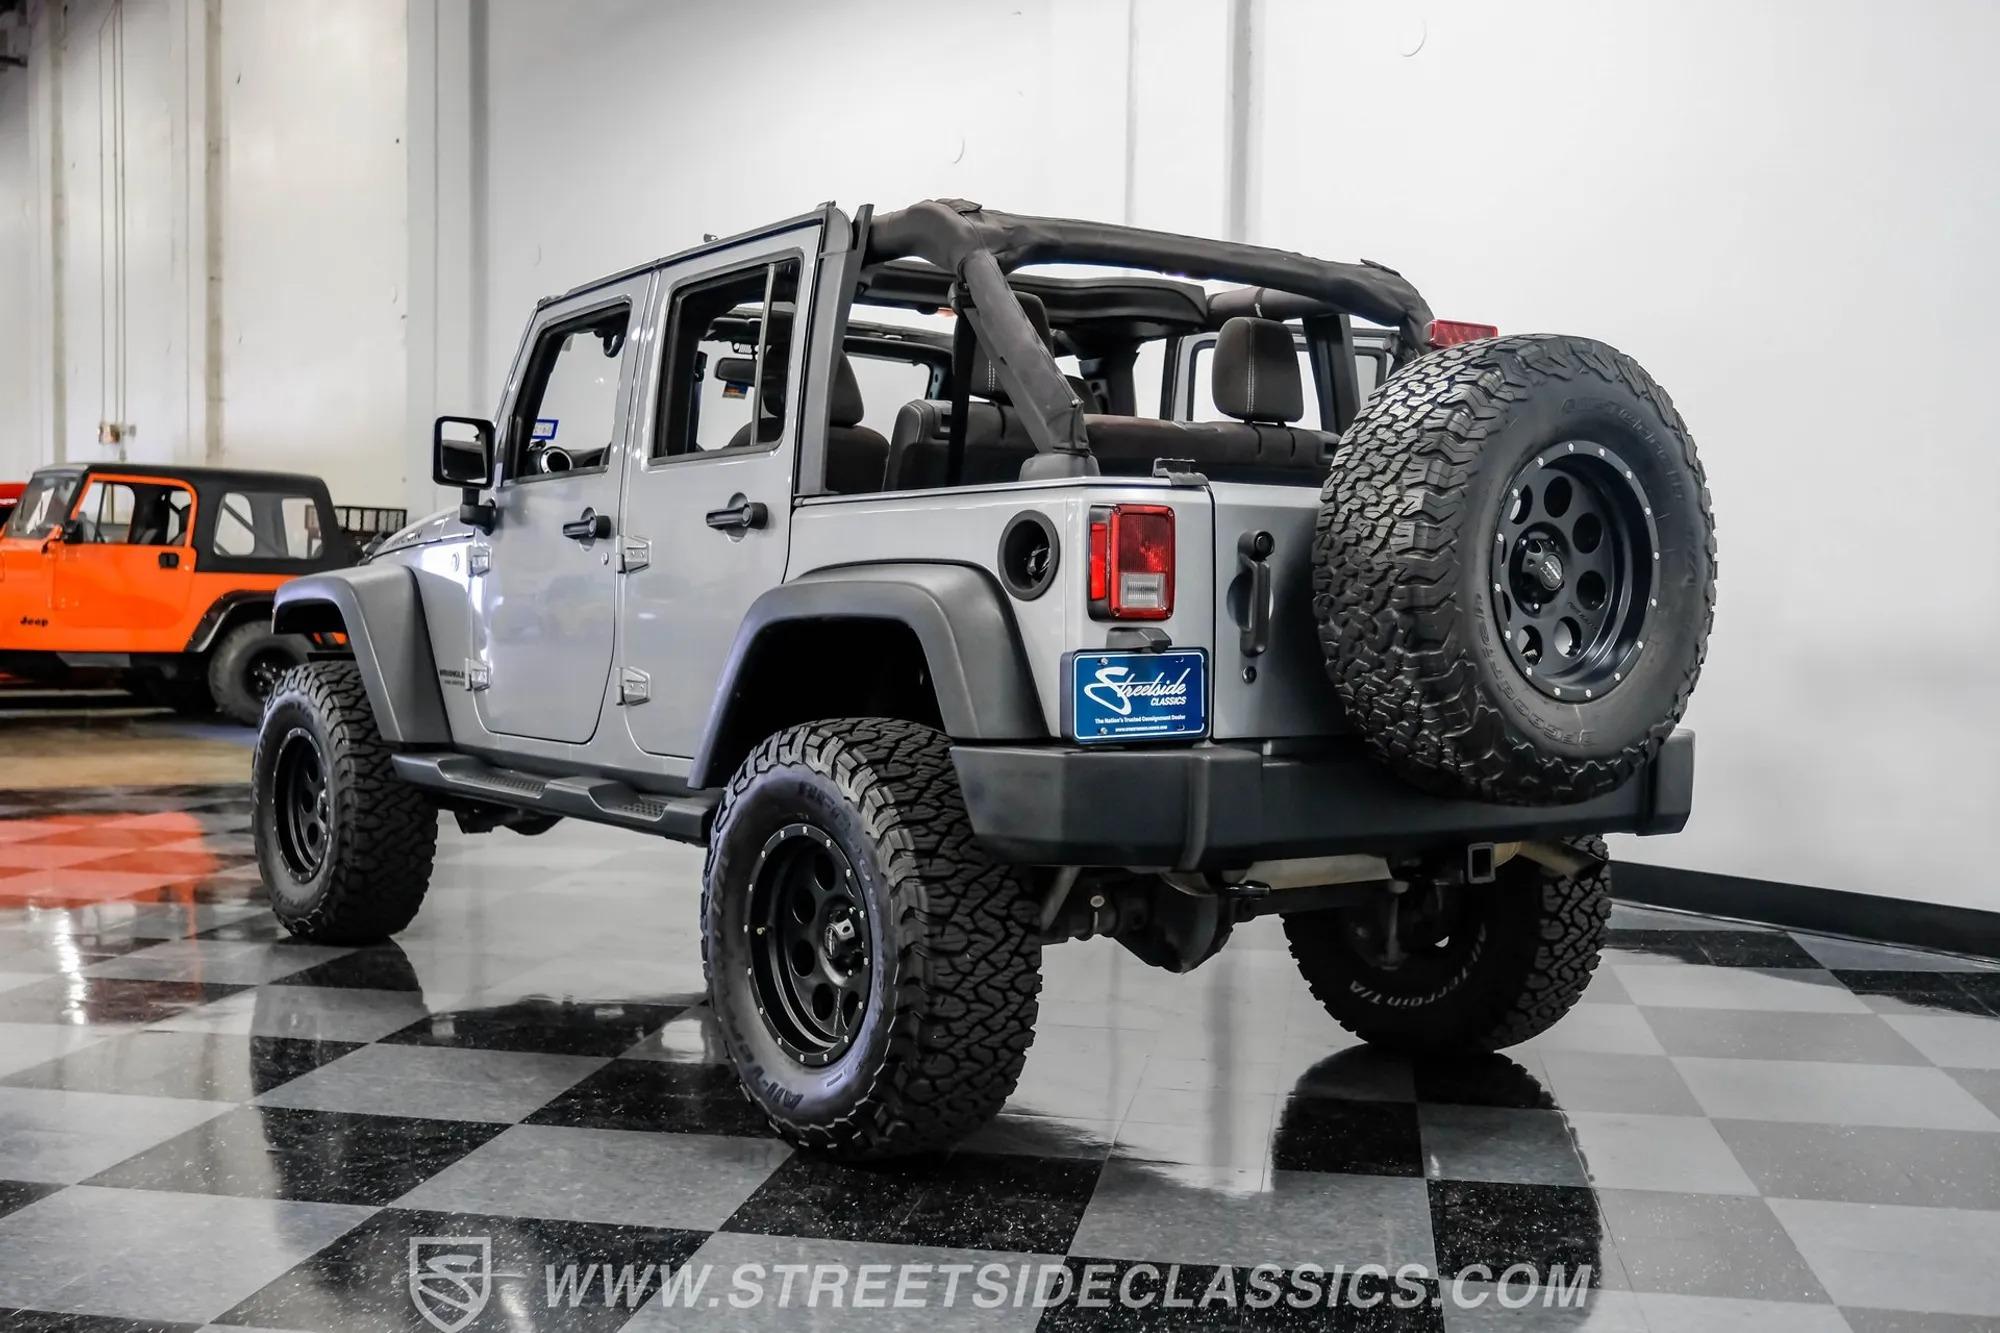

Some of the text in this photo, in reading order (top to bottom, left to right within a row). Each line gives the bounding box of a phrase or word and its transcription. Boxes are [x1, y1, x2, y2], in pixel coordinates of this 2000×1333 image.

[20, 616, 48, 628] Jeep
[1084, 666, 1191, 715] Streetside
[1150, 696, 1187, 706] CLASSICS
